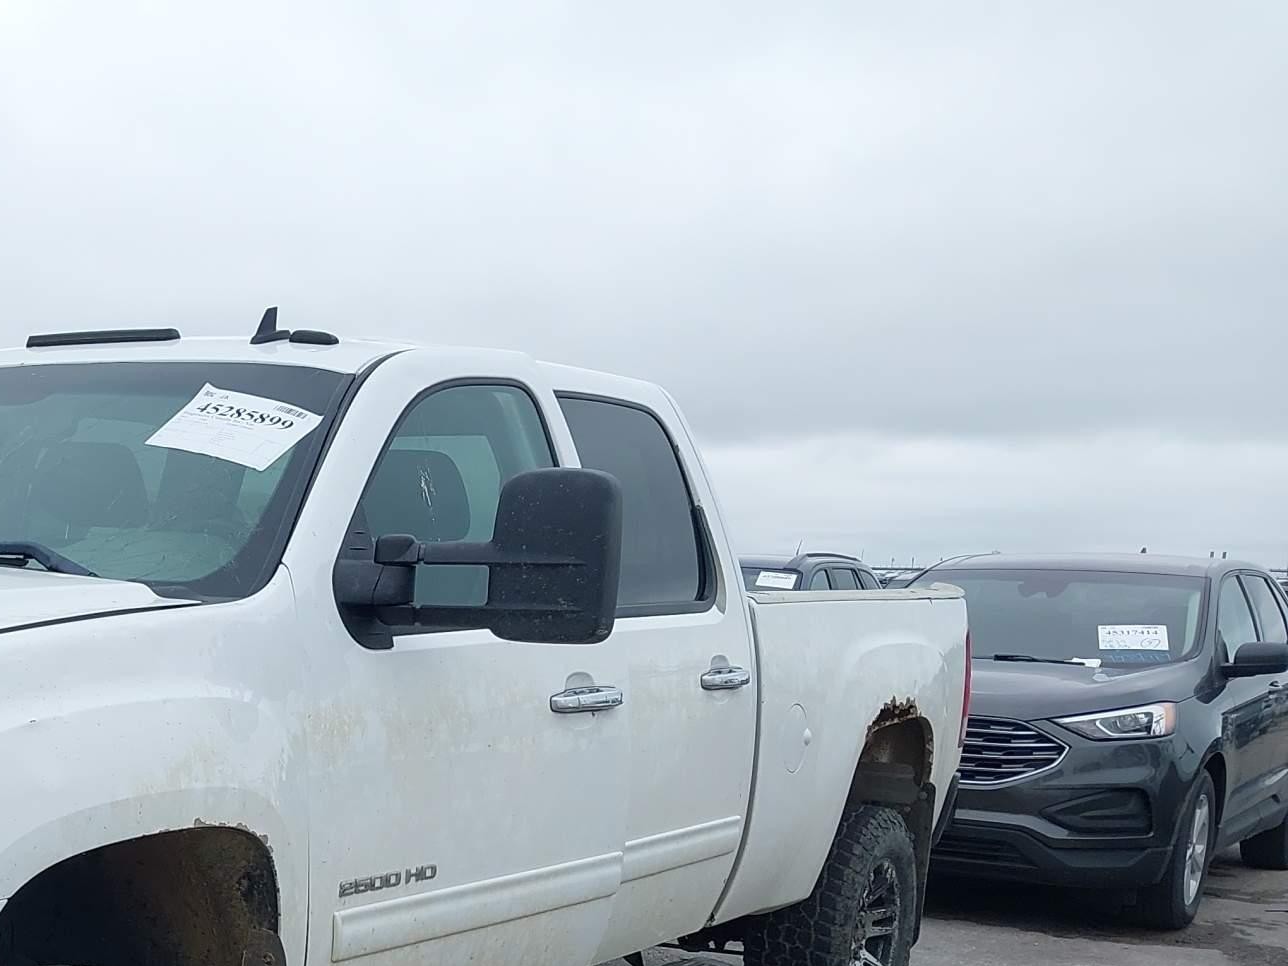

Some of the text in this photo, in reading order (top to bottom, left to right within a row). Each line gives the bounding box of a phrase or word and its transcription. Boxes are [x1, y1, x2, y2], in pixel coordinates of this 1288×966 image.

[196, 401, 294, 430] 45285899
[338, 864, 438, 898] 2500 HD
